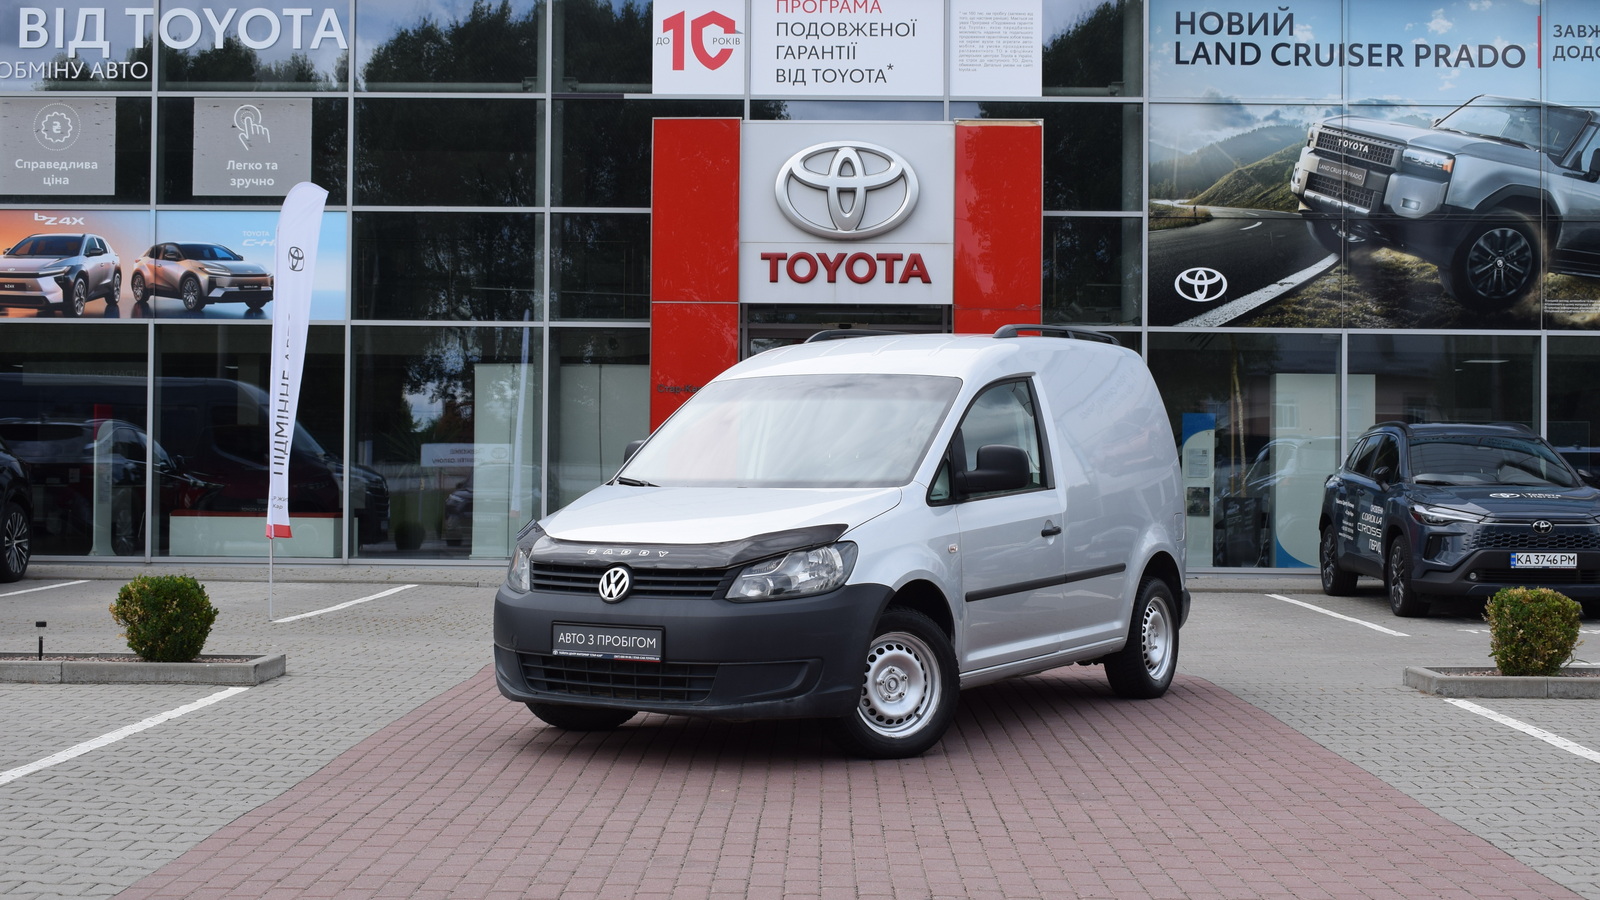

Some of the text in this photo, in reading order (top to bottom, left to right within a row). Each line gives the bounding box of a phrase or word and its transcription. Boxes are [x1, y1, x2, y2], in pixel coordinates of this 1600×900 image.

[776, 0, 883, 14] ПРОГРАМА
[1175, 6, 1294, 36] НОВИЙ
[19, 7, 349, 58] ВІД TOYOTA
[776, 18, 917, 39] ПОДОВЖЕНОЇ
[656, 37, 670, 46] ДО
[712, 37, 741, 45] РОКІВ
[776, 42, 857, 61] ГАРАНТІЇ
[1175, 41, 1526, 69] LAND CRUISER PRADO
[90, 61, 148, 79] АВТО
[776, 68, 806, 86] ВІД
[1338, 139, 1369, 153] TOYOTA
[15, 159, 98, 172] Справедлива
[226, 160, 278, 172] Легко та
[43, 175, 69, 187] ціна
[230, 176, 275, 189] зручно
[761, 251, 931, 284] TOYOTA
[657, 384, 701, 394] Стар-Ка
[1357, 522, 1382, 538] CROSS
[587, 548, 669, 557] CADDY
[1516, 553, 1576, 565] KA 3746 PM
[558, 632, 657, 649] АВТО З ПРОБІГОМ
